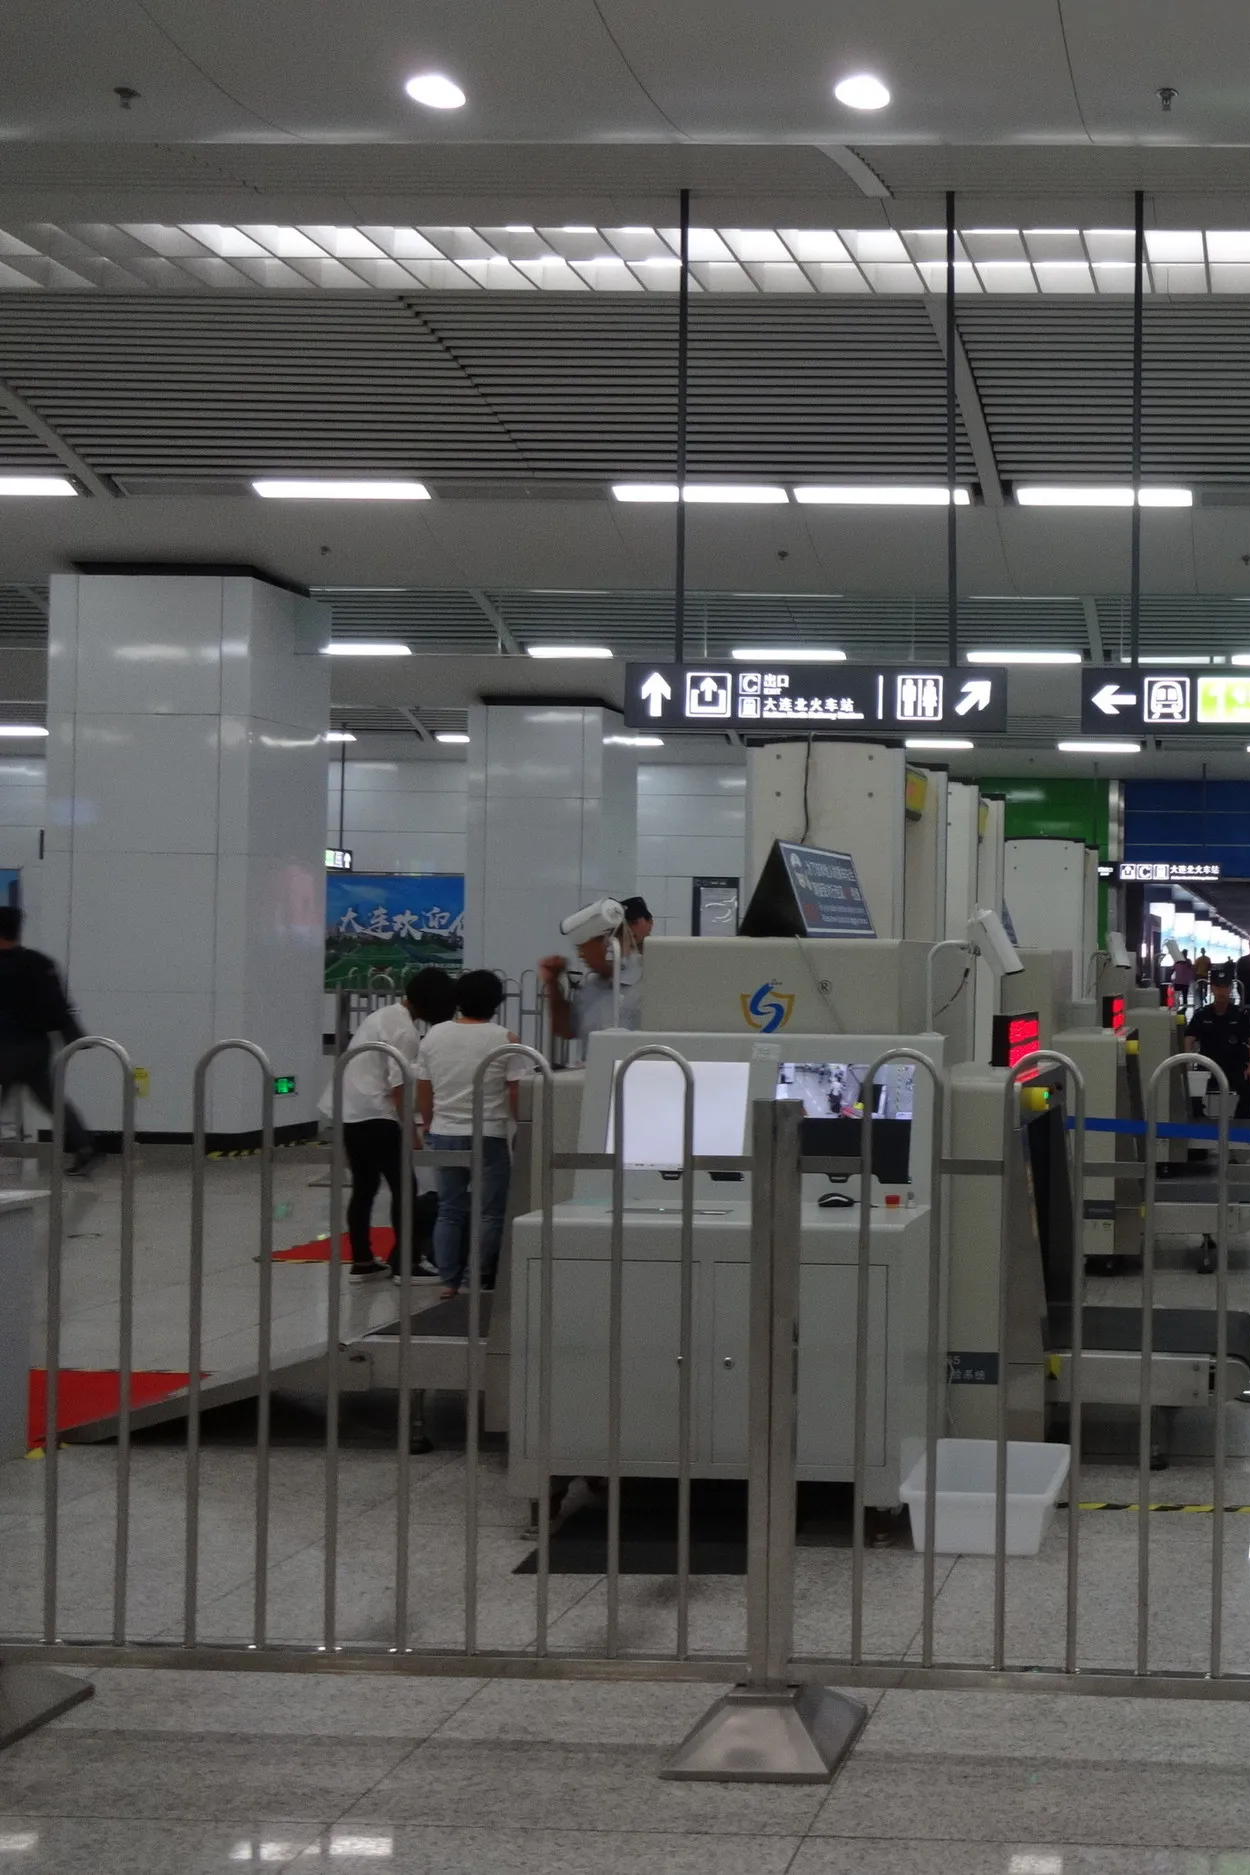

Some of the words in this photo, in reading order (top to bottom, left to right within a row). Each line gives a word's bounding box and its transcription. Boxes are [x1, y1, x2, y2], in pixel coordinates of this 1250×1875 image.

[763, 673, 790, 688] 出口
[763, 697, 855, 712] 大连北火车站
[1169, 864, 1220, 875] 大连北火车站
